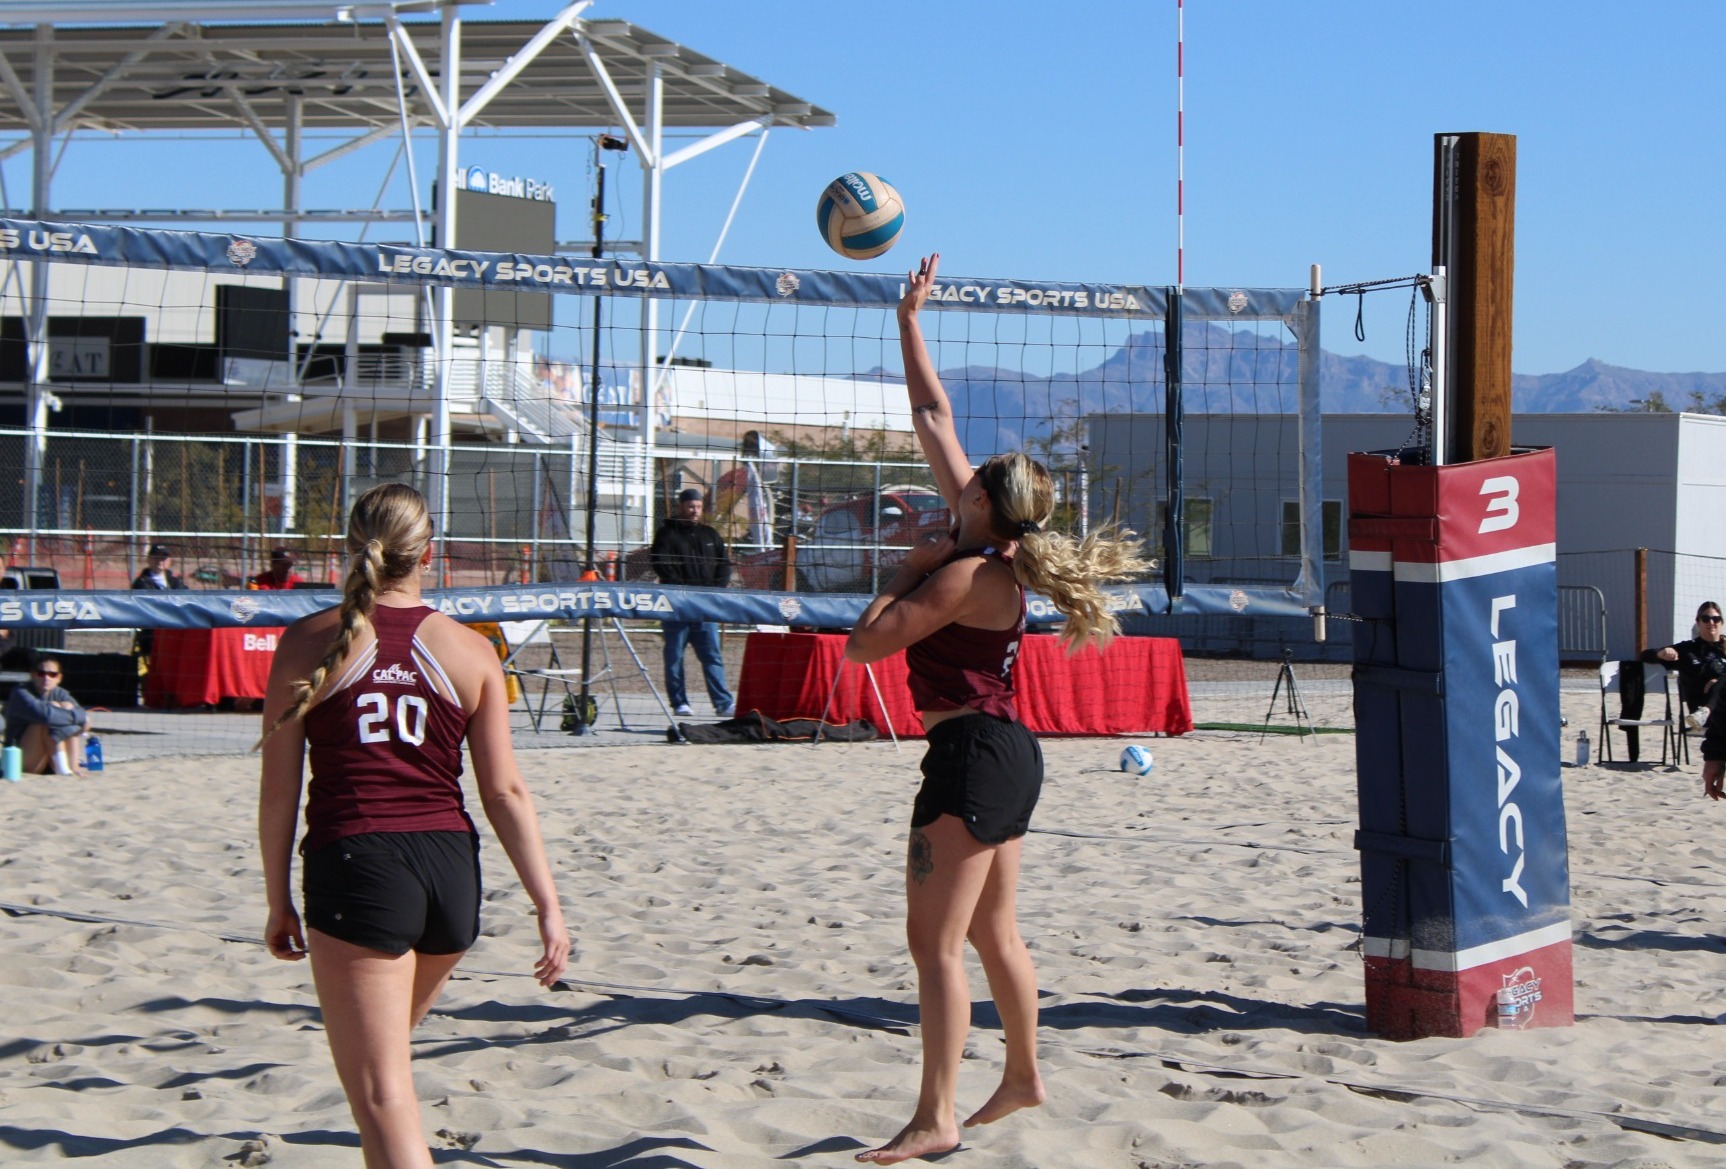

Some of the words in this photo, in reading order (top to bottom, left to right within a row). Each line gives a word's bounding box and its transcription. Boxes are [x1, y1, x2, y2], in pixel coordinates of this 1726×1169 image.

[488, 172, 525, 198] Bank
[526, 178, 555, 202] Park
[28, 230, 99, 254] USA
[378, 253, 490, 278] LEGACY
[495, 261, 607, 286] SPORTS
[614, 268, 671, 289] USA
[900, 283, 992, 303] LGACY
[996, 287, 1089, 308] SPORTS
[1094, 292, 1141, 310] USA
[1477, 475, 1520, 535] 3
[31, 601, 102, 620] USA
[501, 592, 612, 613] SPORTS
[617, 592, 674, 612] USA
[244, 633, 277, 651] Bell
[396, 670, 418, 682] PAC
[357, 692, 428, 747] 20
[1491, 594, 1528, 910] LEGACY
